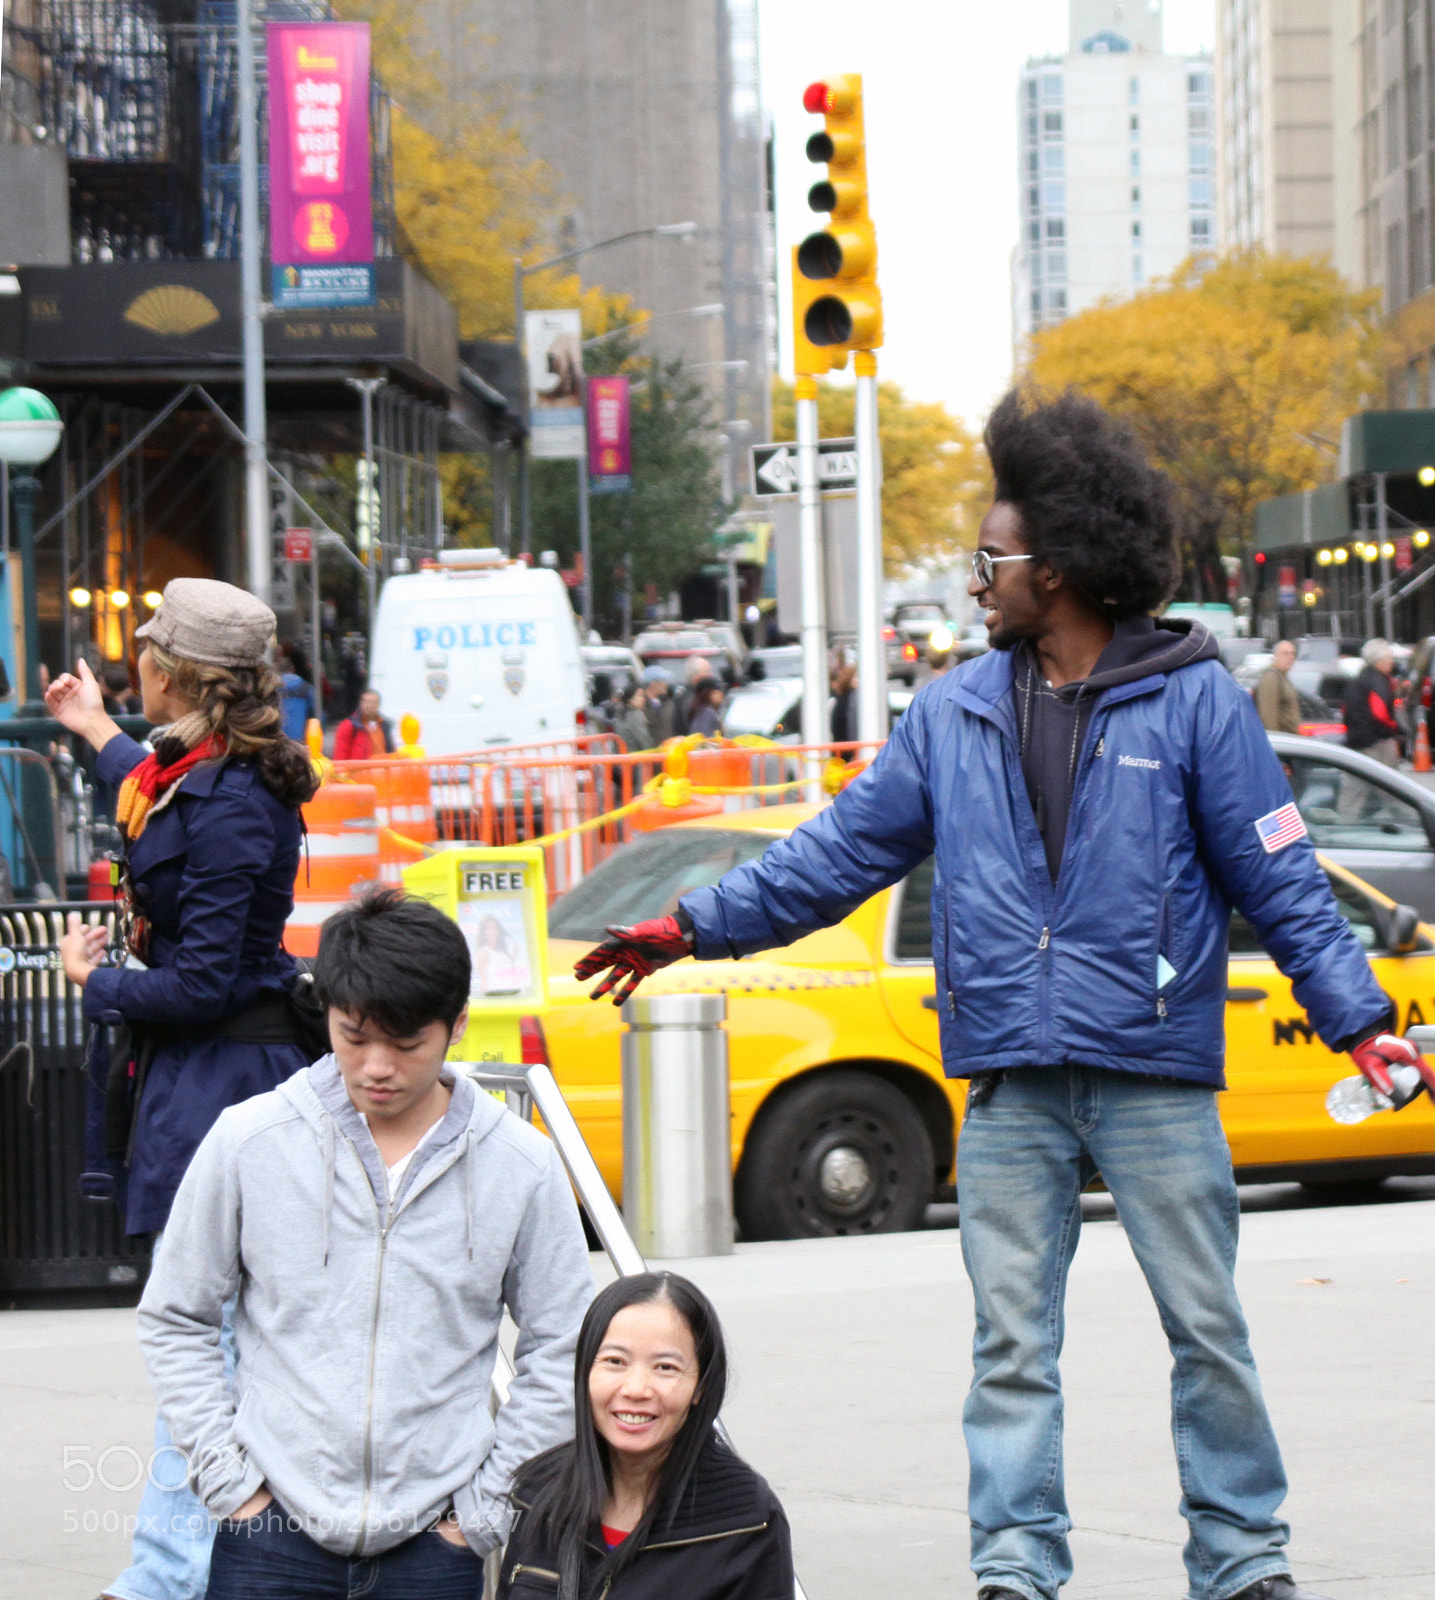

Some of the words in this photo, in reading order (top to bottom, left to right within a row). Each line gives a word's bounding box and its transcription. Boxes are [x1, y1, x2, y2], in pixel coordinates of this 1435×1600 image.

[301, 267, 370, 277] MANHATTAN
[285, 323, 322, 337] NEW
[330, 323, 378, 337] YORK
[773, 457, 801, 480] ON
[413, 622, 537, 650] POLICE
[1117, 754, 1162, 770] Marmot
[466, 872, 523, 891] FREE
[16, 951, 48, 969] Keep
